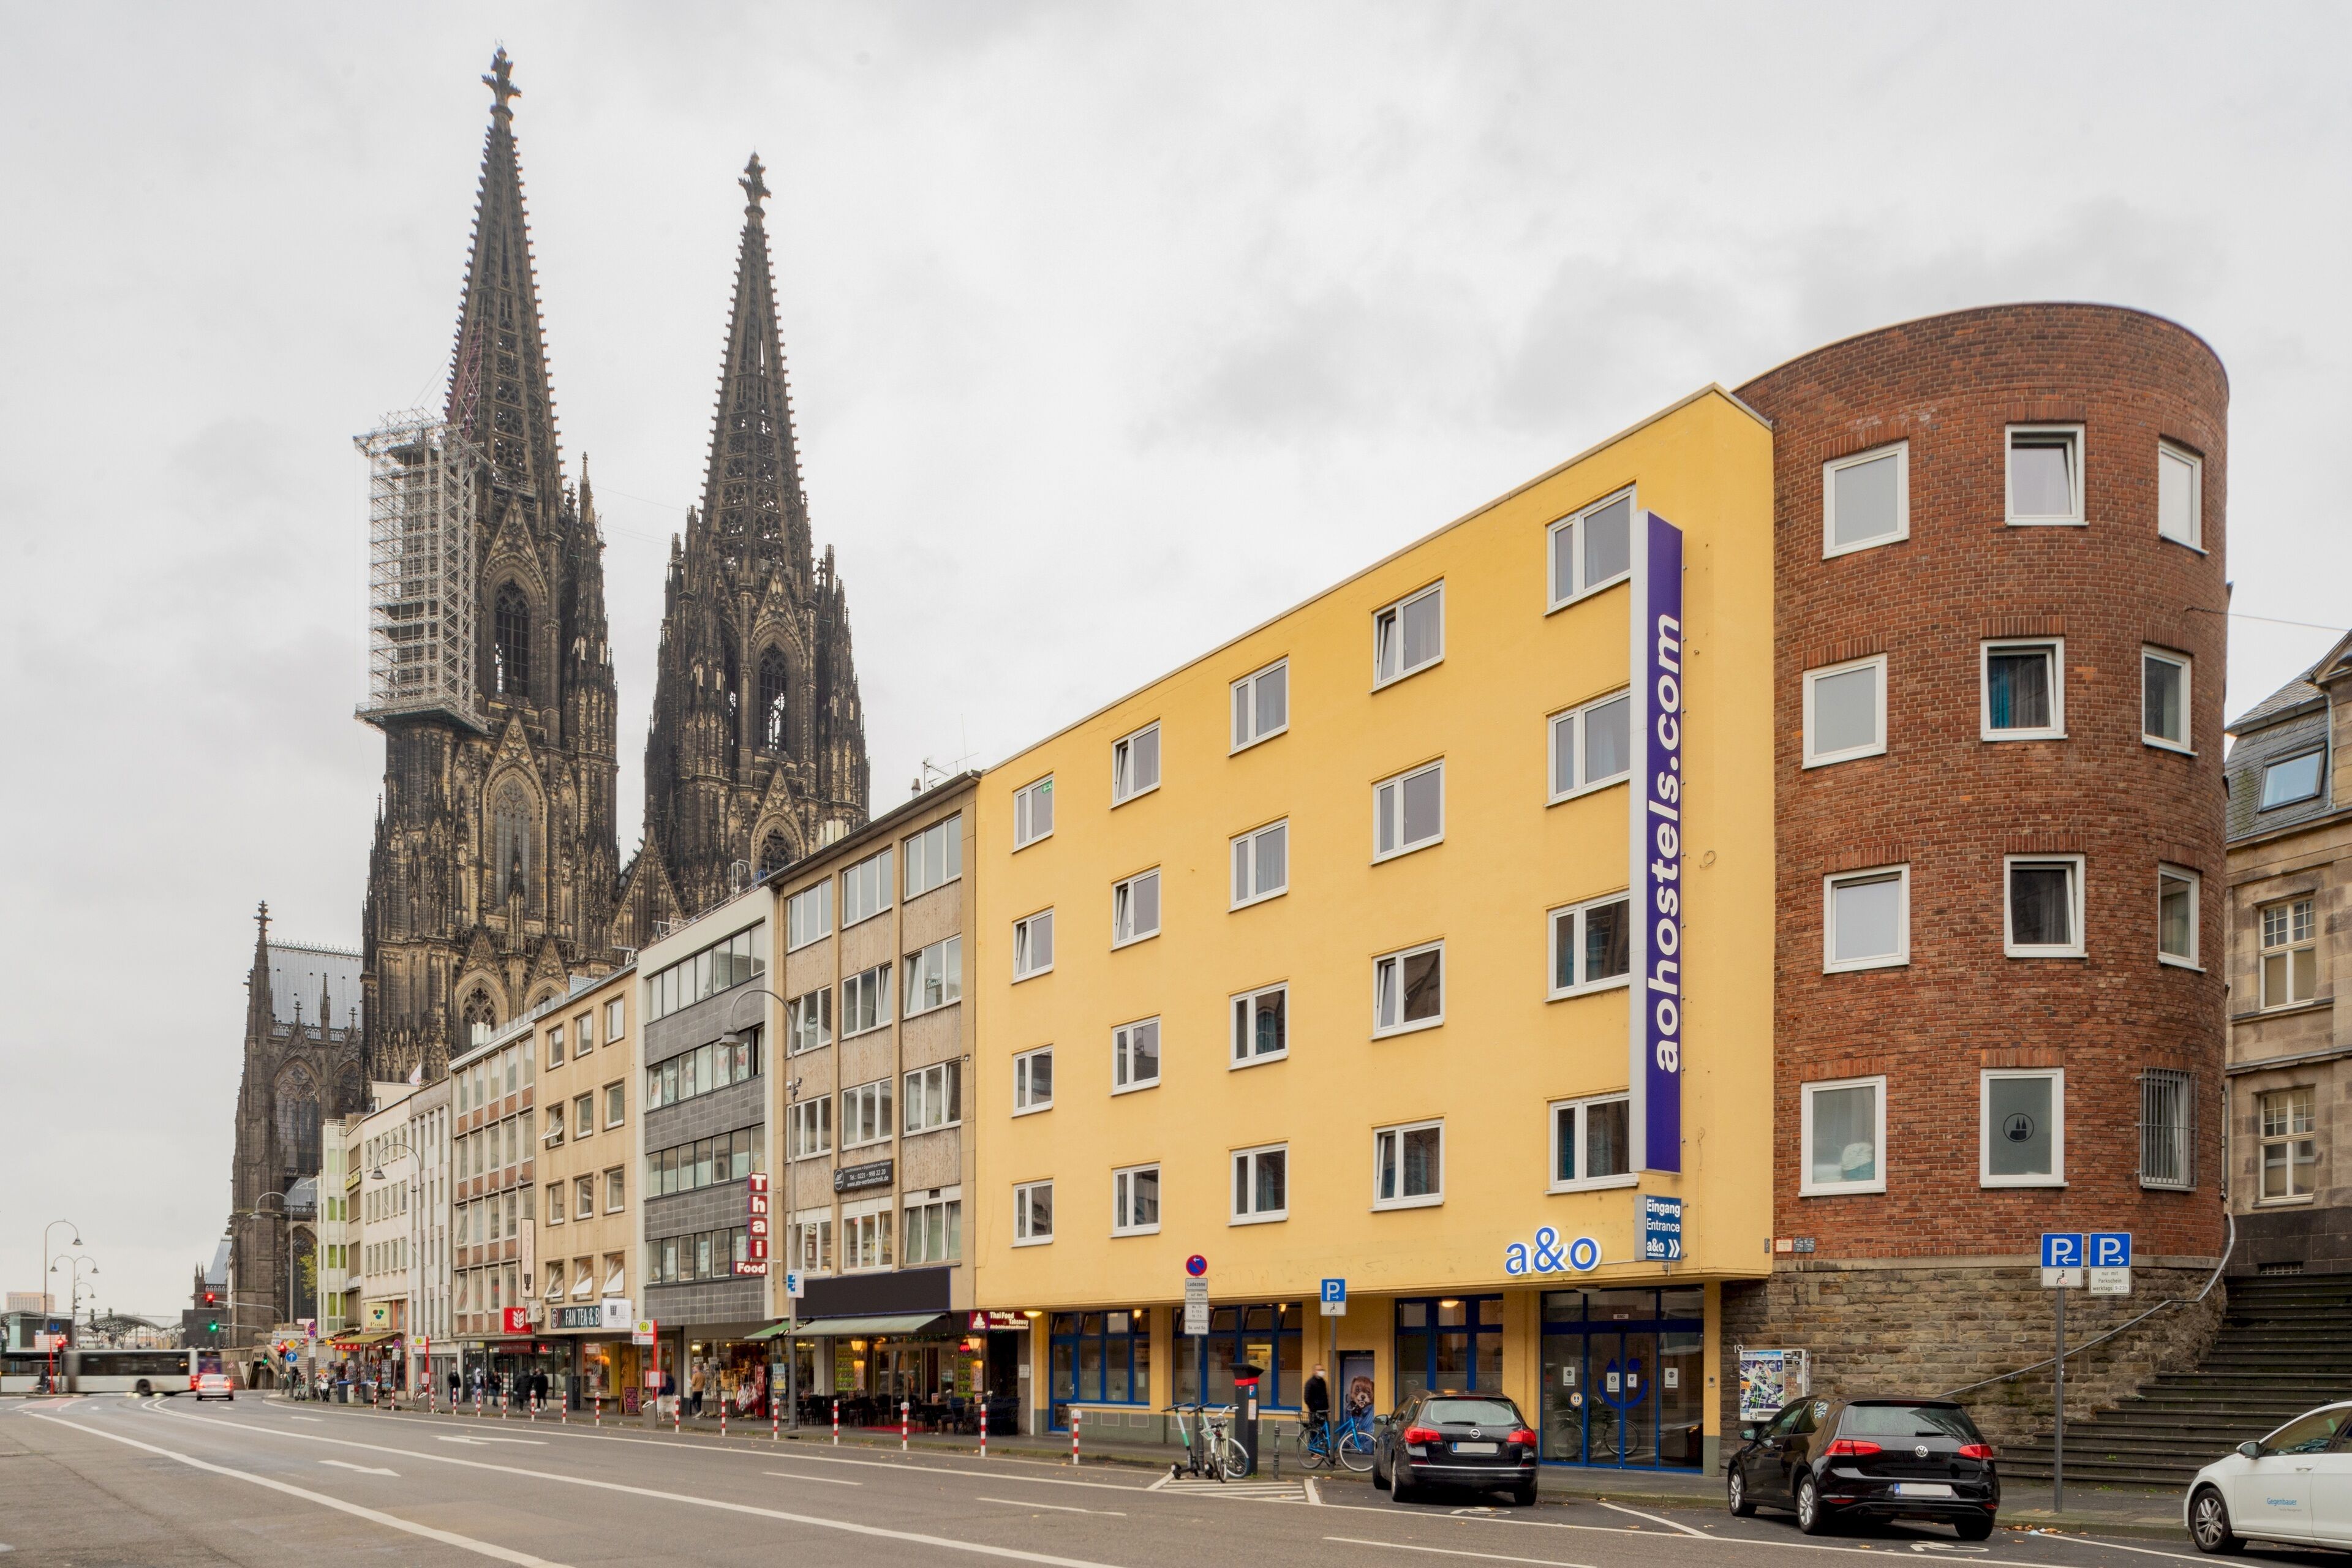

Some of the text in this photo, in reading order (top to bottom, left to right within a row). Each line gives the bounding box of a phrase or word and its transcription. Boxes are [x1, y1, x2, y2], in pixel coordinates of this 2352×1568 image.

[1648, 614, 1679, 1074] aohostels.com
[847, 1175, 889, 1188] www.ate-werbetechnik.de
[751, 1174, 766, 1257] Thai
[1646, 1199, 1681, 1218] Eingang
[1646, 1218, 1681, 1232] Entrance
[1505, 1226, 1602, 1276] a&o
[1646, 1237, 1665, 1253] a&o
[2051, 1238, 2073, 1265] P
[2099, 1237, 2121, 1265] P
[737, 1262, 766, 1274] Food
[1327, 1282, 1340, 1300] P
[565, 1307, 601, 1326] FAN TEA & B
[2267, 1497, 2297, 1506] Gegenbauer
